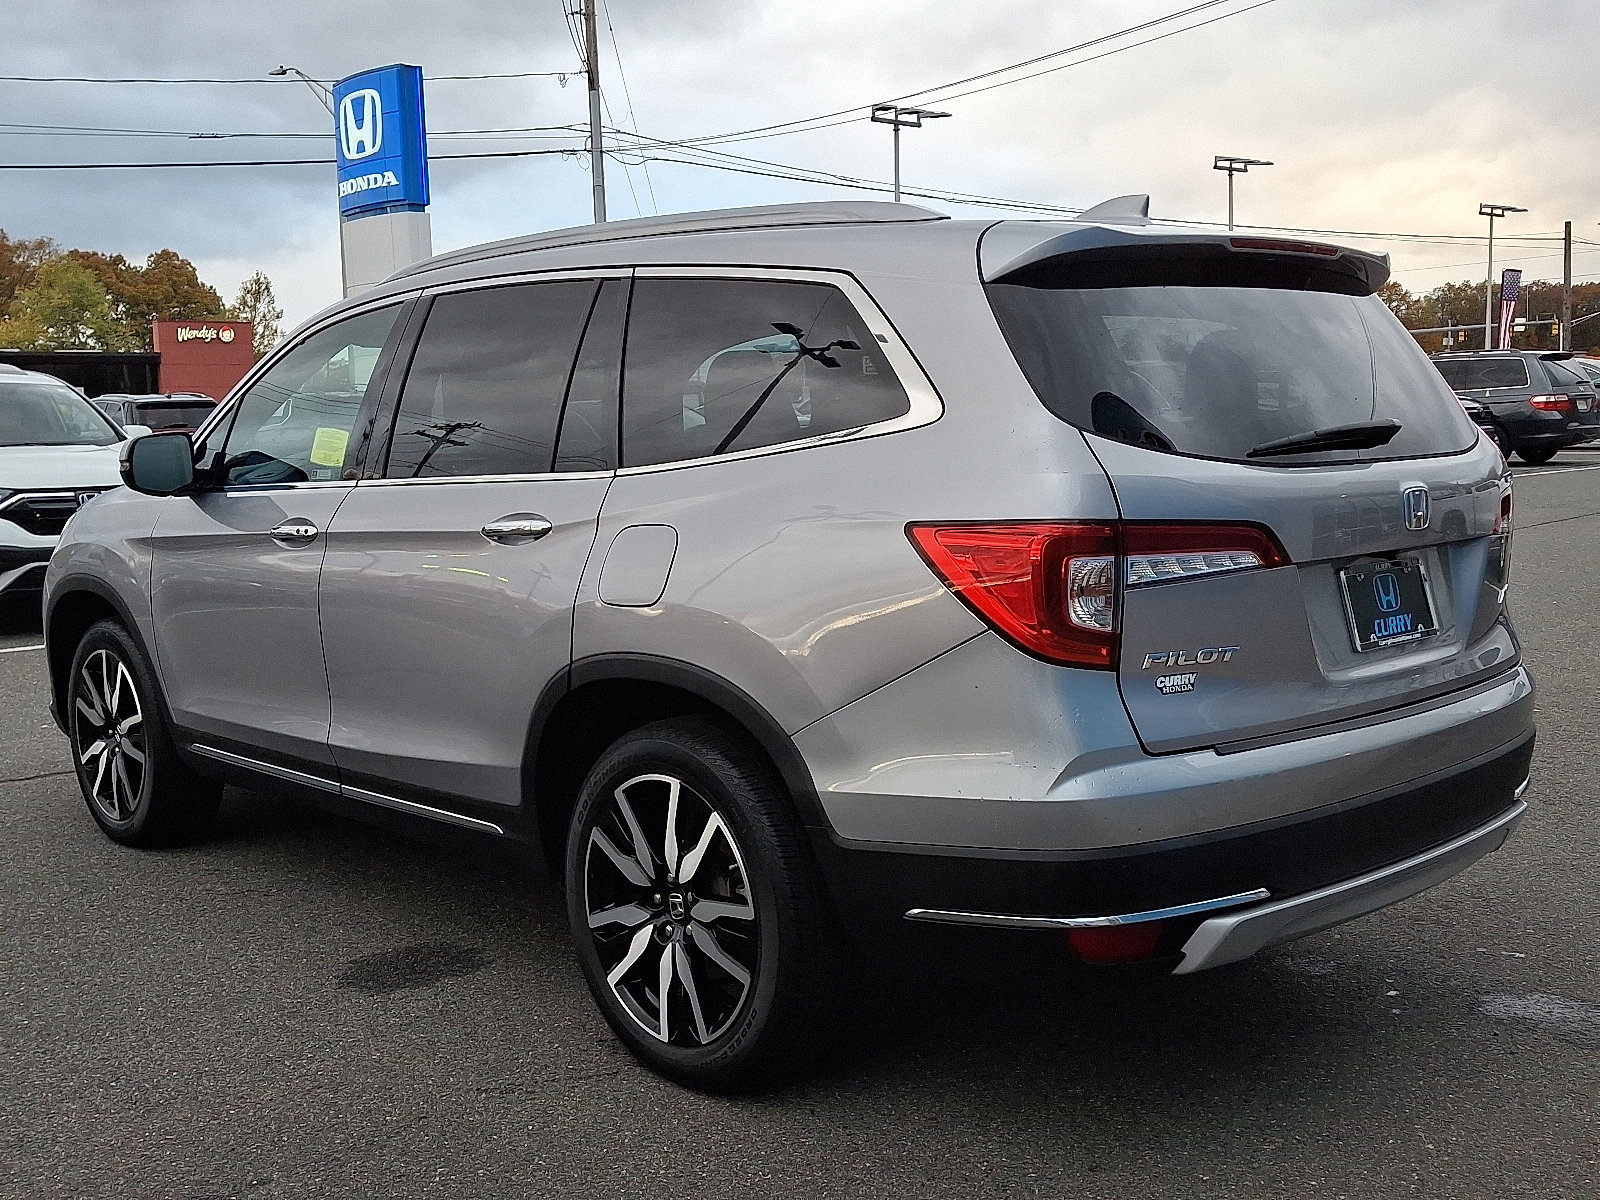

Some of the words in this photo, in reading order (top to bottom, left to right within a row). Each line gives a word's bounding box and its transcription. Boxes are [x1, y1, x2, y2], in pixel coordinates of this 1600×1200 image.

[338, 170, 400, 198] HONDA
[177, 325, 218, 343] Wendy's
[1374, 613, 1412, 637] CURRY
[1141, 645, 1241, 670] PILOT
[1156, 672, 1198, 688] CURRY
[1162, 683, 1194, 694] HONDA
